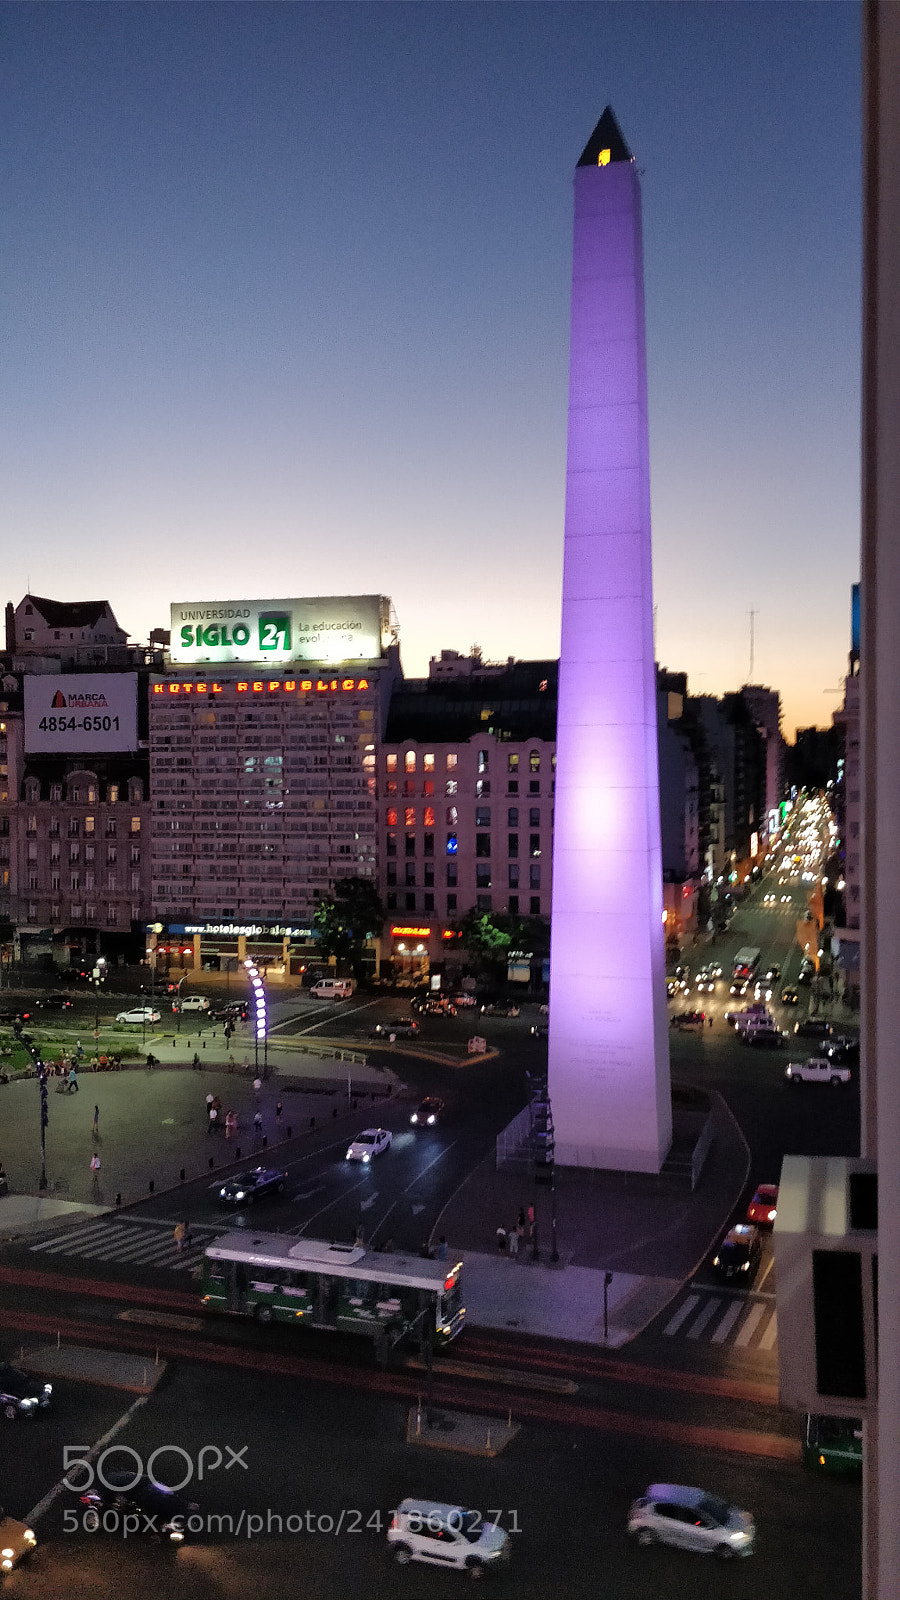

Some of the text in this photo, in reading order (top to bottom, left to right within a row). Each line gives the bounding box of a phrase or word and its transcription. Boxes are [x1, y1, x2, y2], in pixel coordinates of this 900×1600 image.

[179, 608, 251, 621] UNIVERSIDAD
[299, 620, 362, 632] La educación
[180, 622, 286, 650] SIGLO 21
[153, 679, 369, 694] HOTEL REPUBLICA
[68, 693, 106, 701] MARCA
[68, 700, 109, 708] URBANA
[38, 716, 120, 732] 4854-6501
[184, 923, 312, 937] www.hotelesglobales.com
